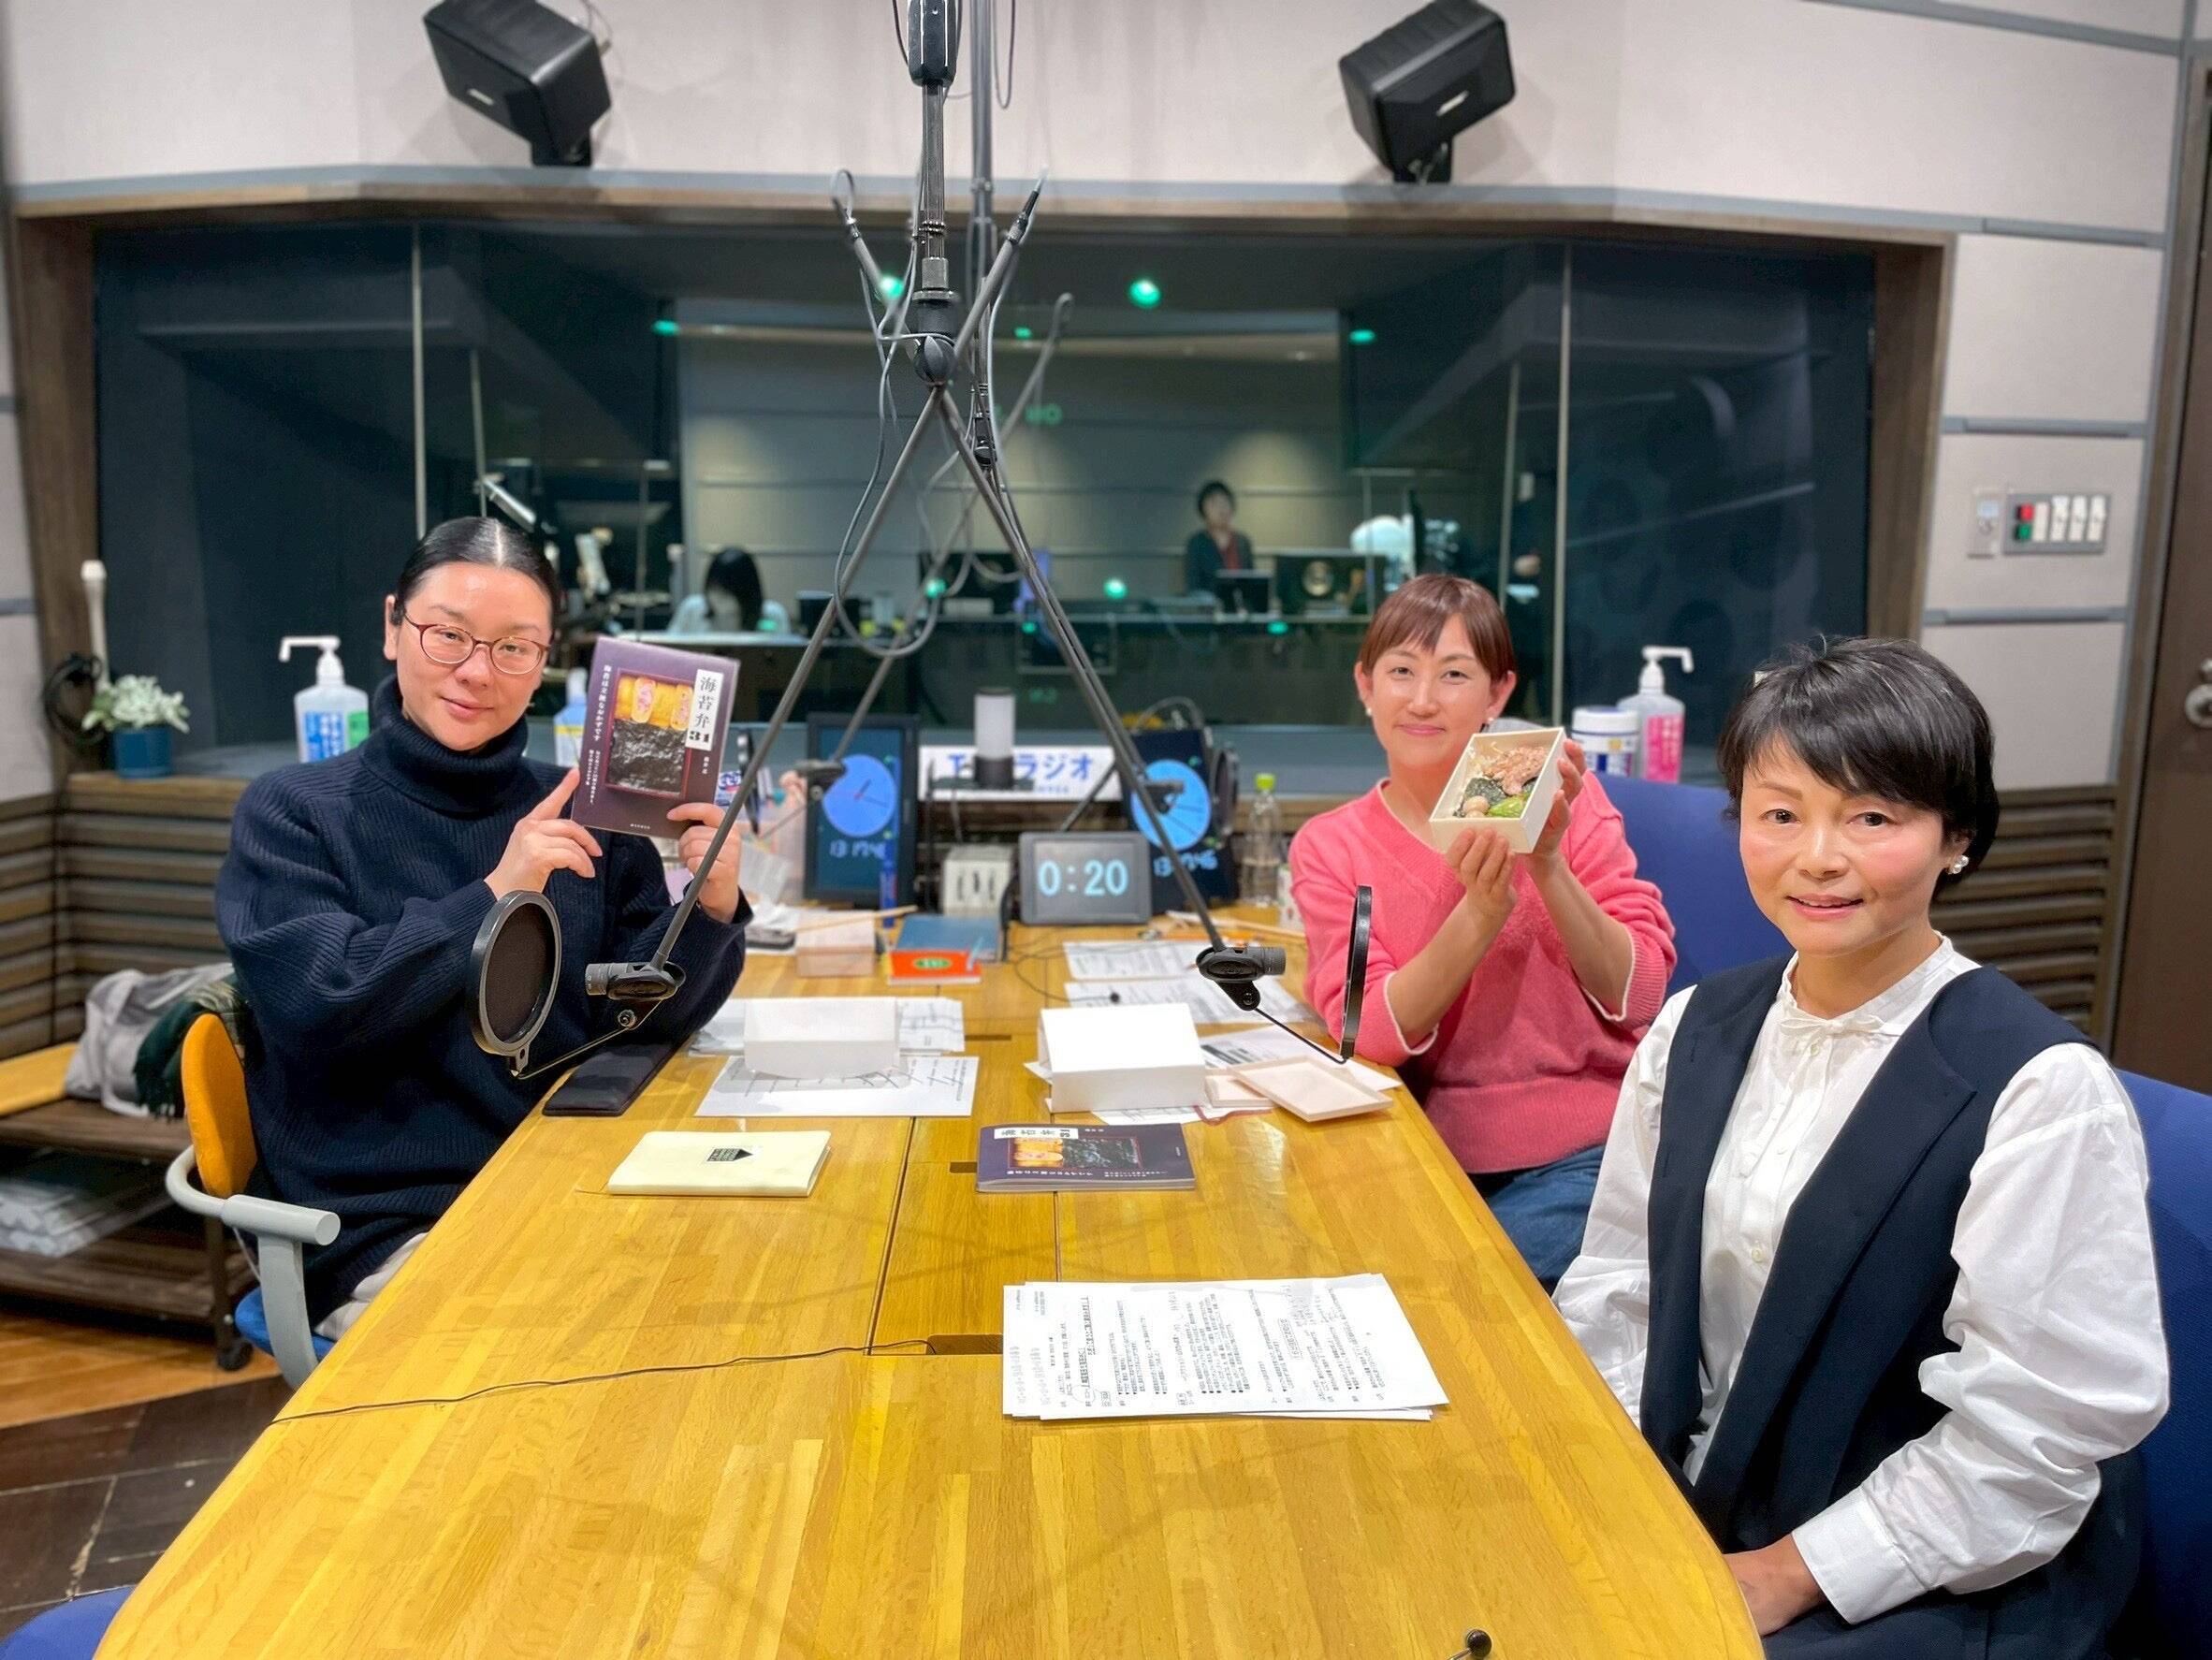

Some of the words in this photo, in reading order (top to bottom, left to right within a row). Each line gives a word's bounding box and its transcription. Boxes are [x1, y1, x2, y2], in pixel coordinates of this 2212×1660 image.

[949, 752, 1093, 780] Tラジオ
[1038, 859, 1129, 896] 0:20
